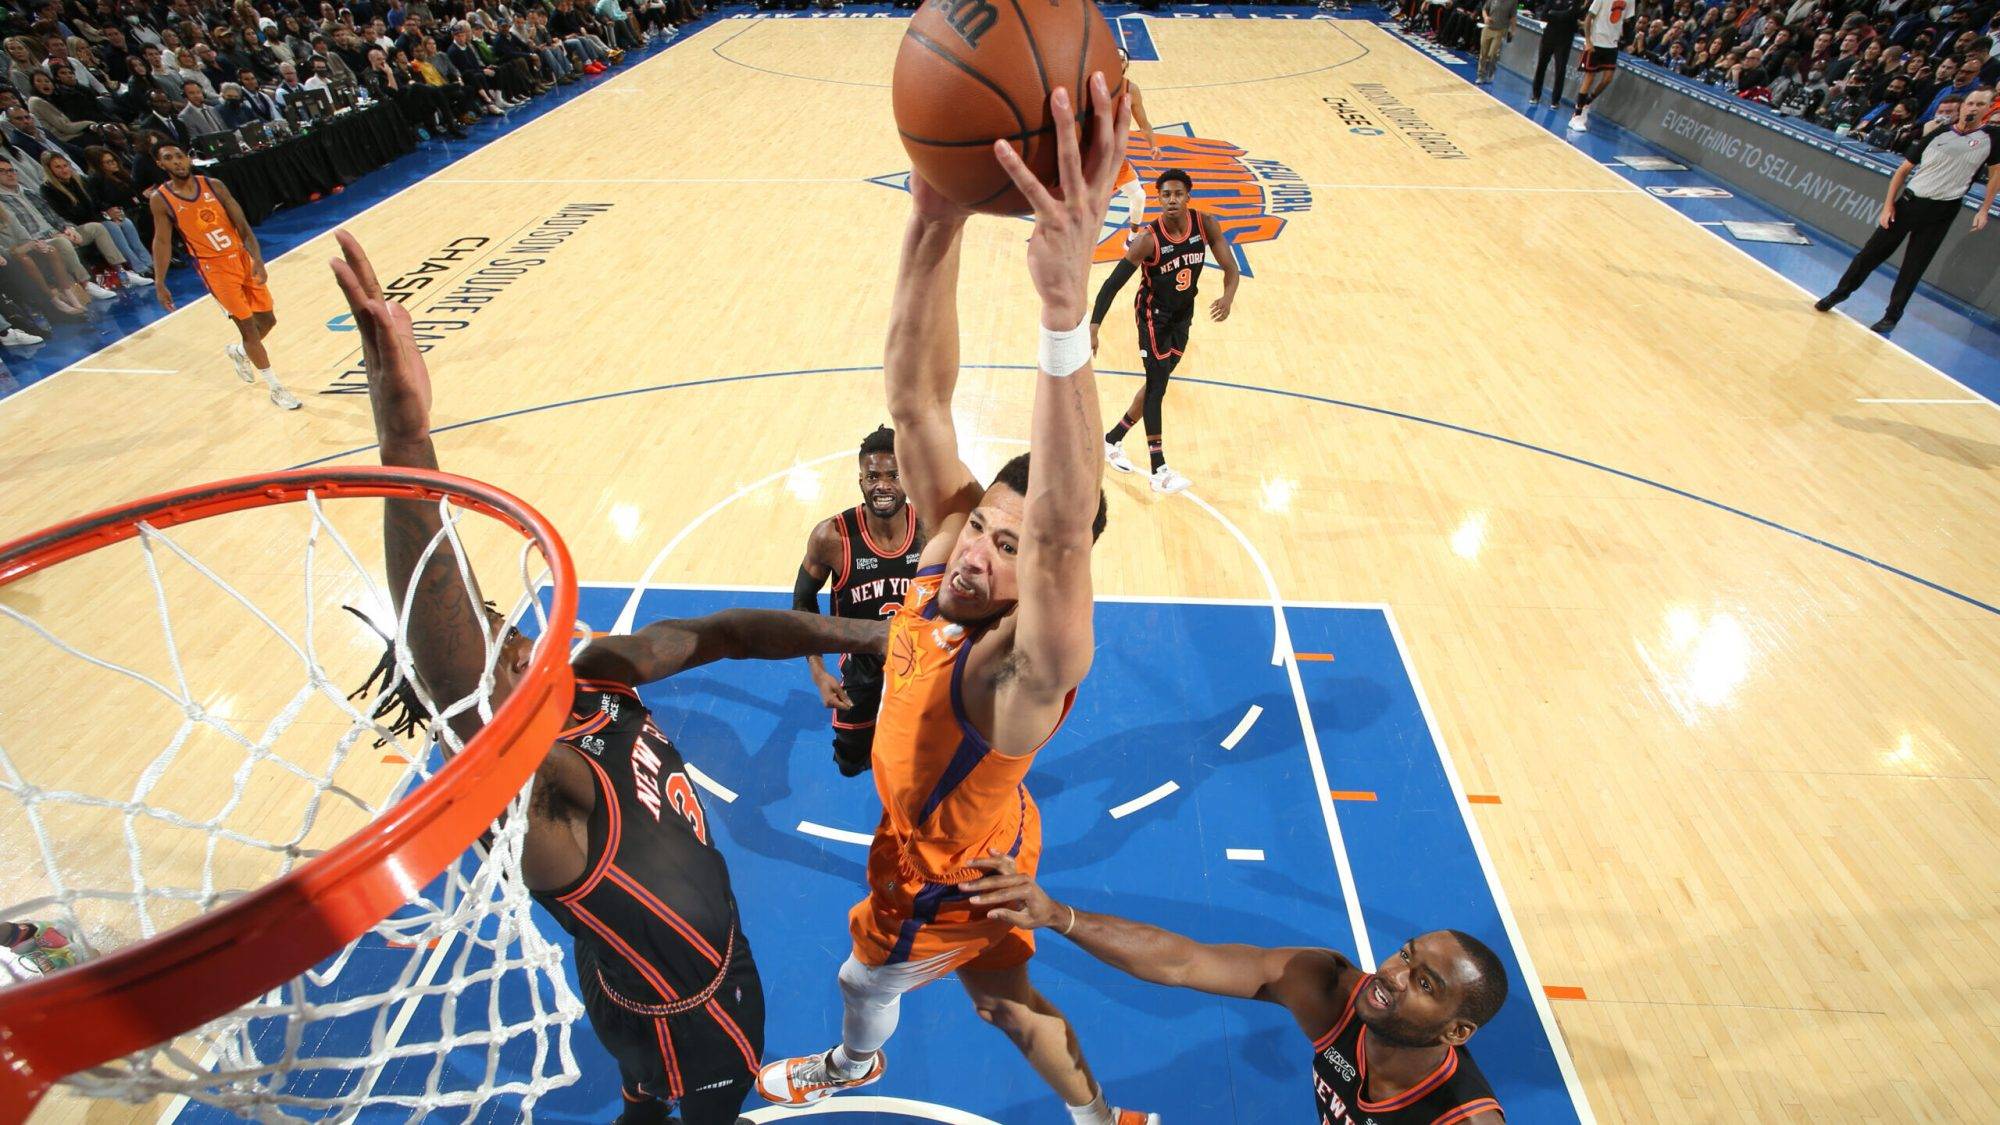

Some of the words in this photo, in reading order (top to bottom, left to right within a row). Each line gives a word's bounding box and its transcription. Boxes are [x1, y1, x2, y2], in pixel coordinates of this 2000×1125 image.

[1322, 97, 1373, 126] CHASE
[1246, 158, 1304, 182] NEW
[1661, 109, 1742, 159] EVERYTHING
[1738, 143, 1762, 169] TO
[1759, 153, 1799, 188] SELL
[1794, 171, 1886, 226] ANYTHIN
[1268, 183, 1313, 214] YORK
[205, 228, 232, 252] 15
[505, 203, 615, 254] MADISON
[1160, 256, 1181, 275] NEW
[1175, 267, 1192, 292] 9
[425, 258, 546, 314] SQUARE
[850, 579, 886, 605] NEW
[889, 578, 913, 596] YO
[631, 735, 662, 824] NEW
[665, 772, 708, 847] 3
